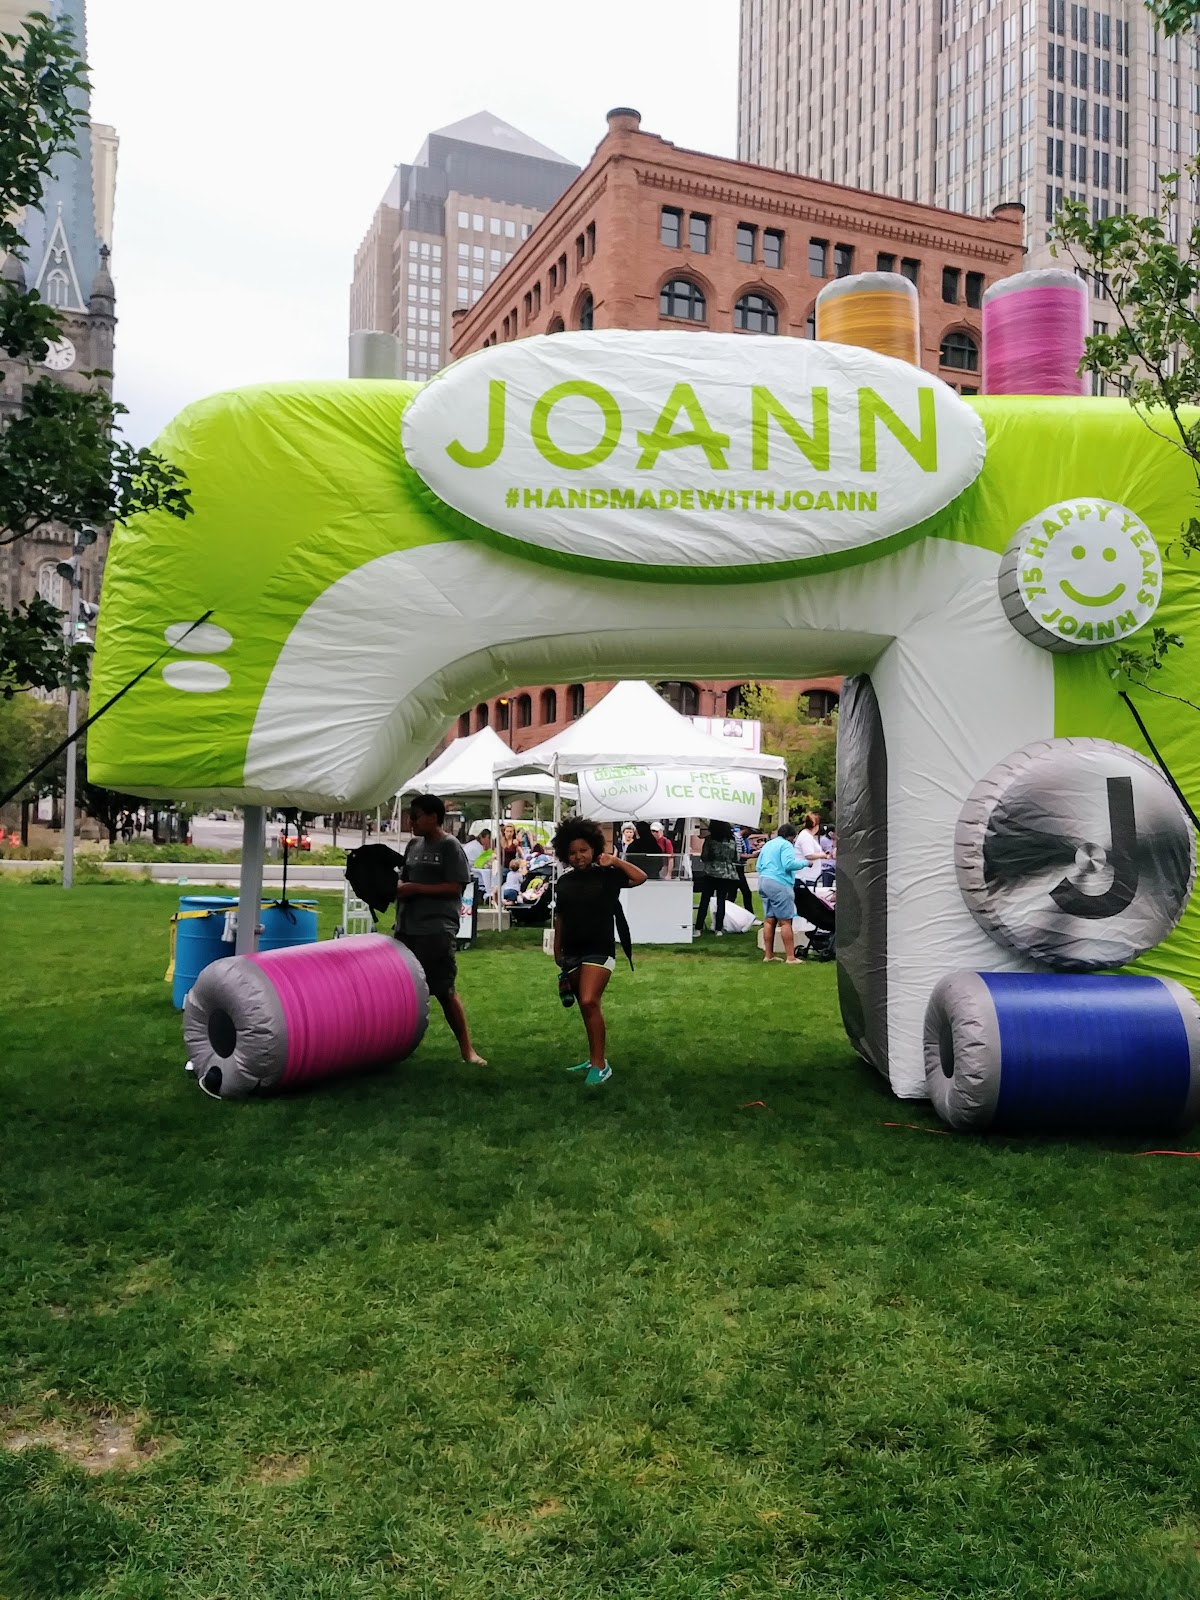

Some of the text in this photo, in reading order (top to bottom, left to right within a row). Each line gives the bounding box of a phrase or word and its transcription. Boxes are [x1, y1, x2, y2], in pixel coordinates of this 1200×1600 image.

[445, 379, 938, 473] JOANN
[505, 487, 877, 512] #HANDMADEWITHJOANN
[1025, 504, 1112, 559] HAPPY
[1120, 513, 1159, 608] YEARS
[1041, 608, 1139, 641] JOANN
[600, 783, 649, 798] JOANN
[690, 771, 731, 786] FREE
[665, 785, 756, 806] ICE CREAM
[1049, 776, 1139, 920] J
